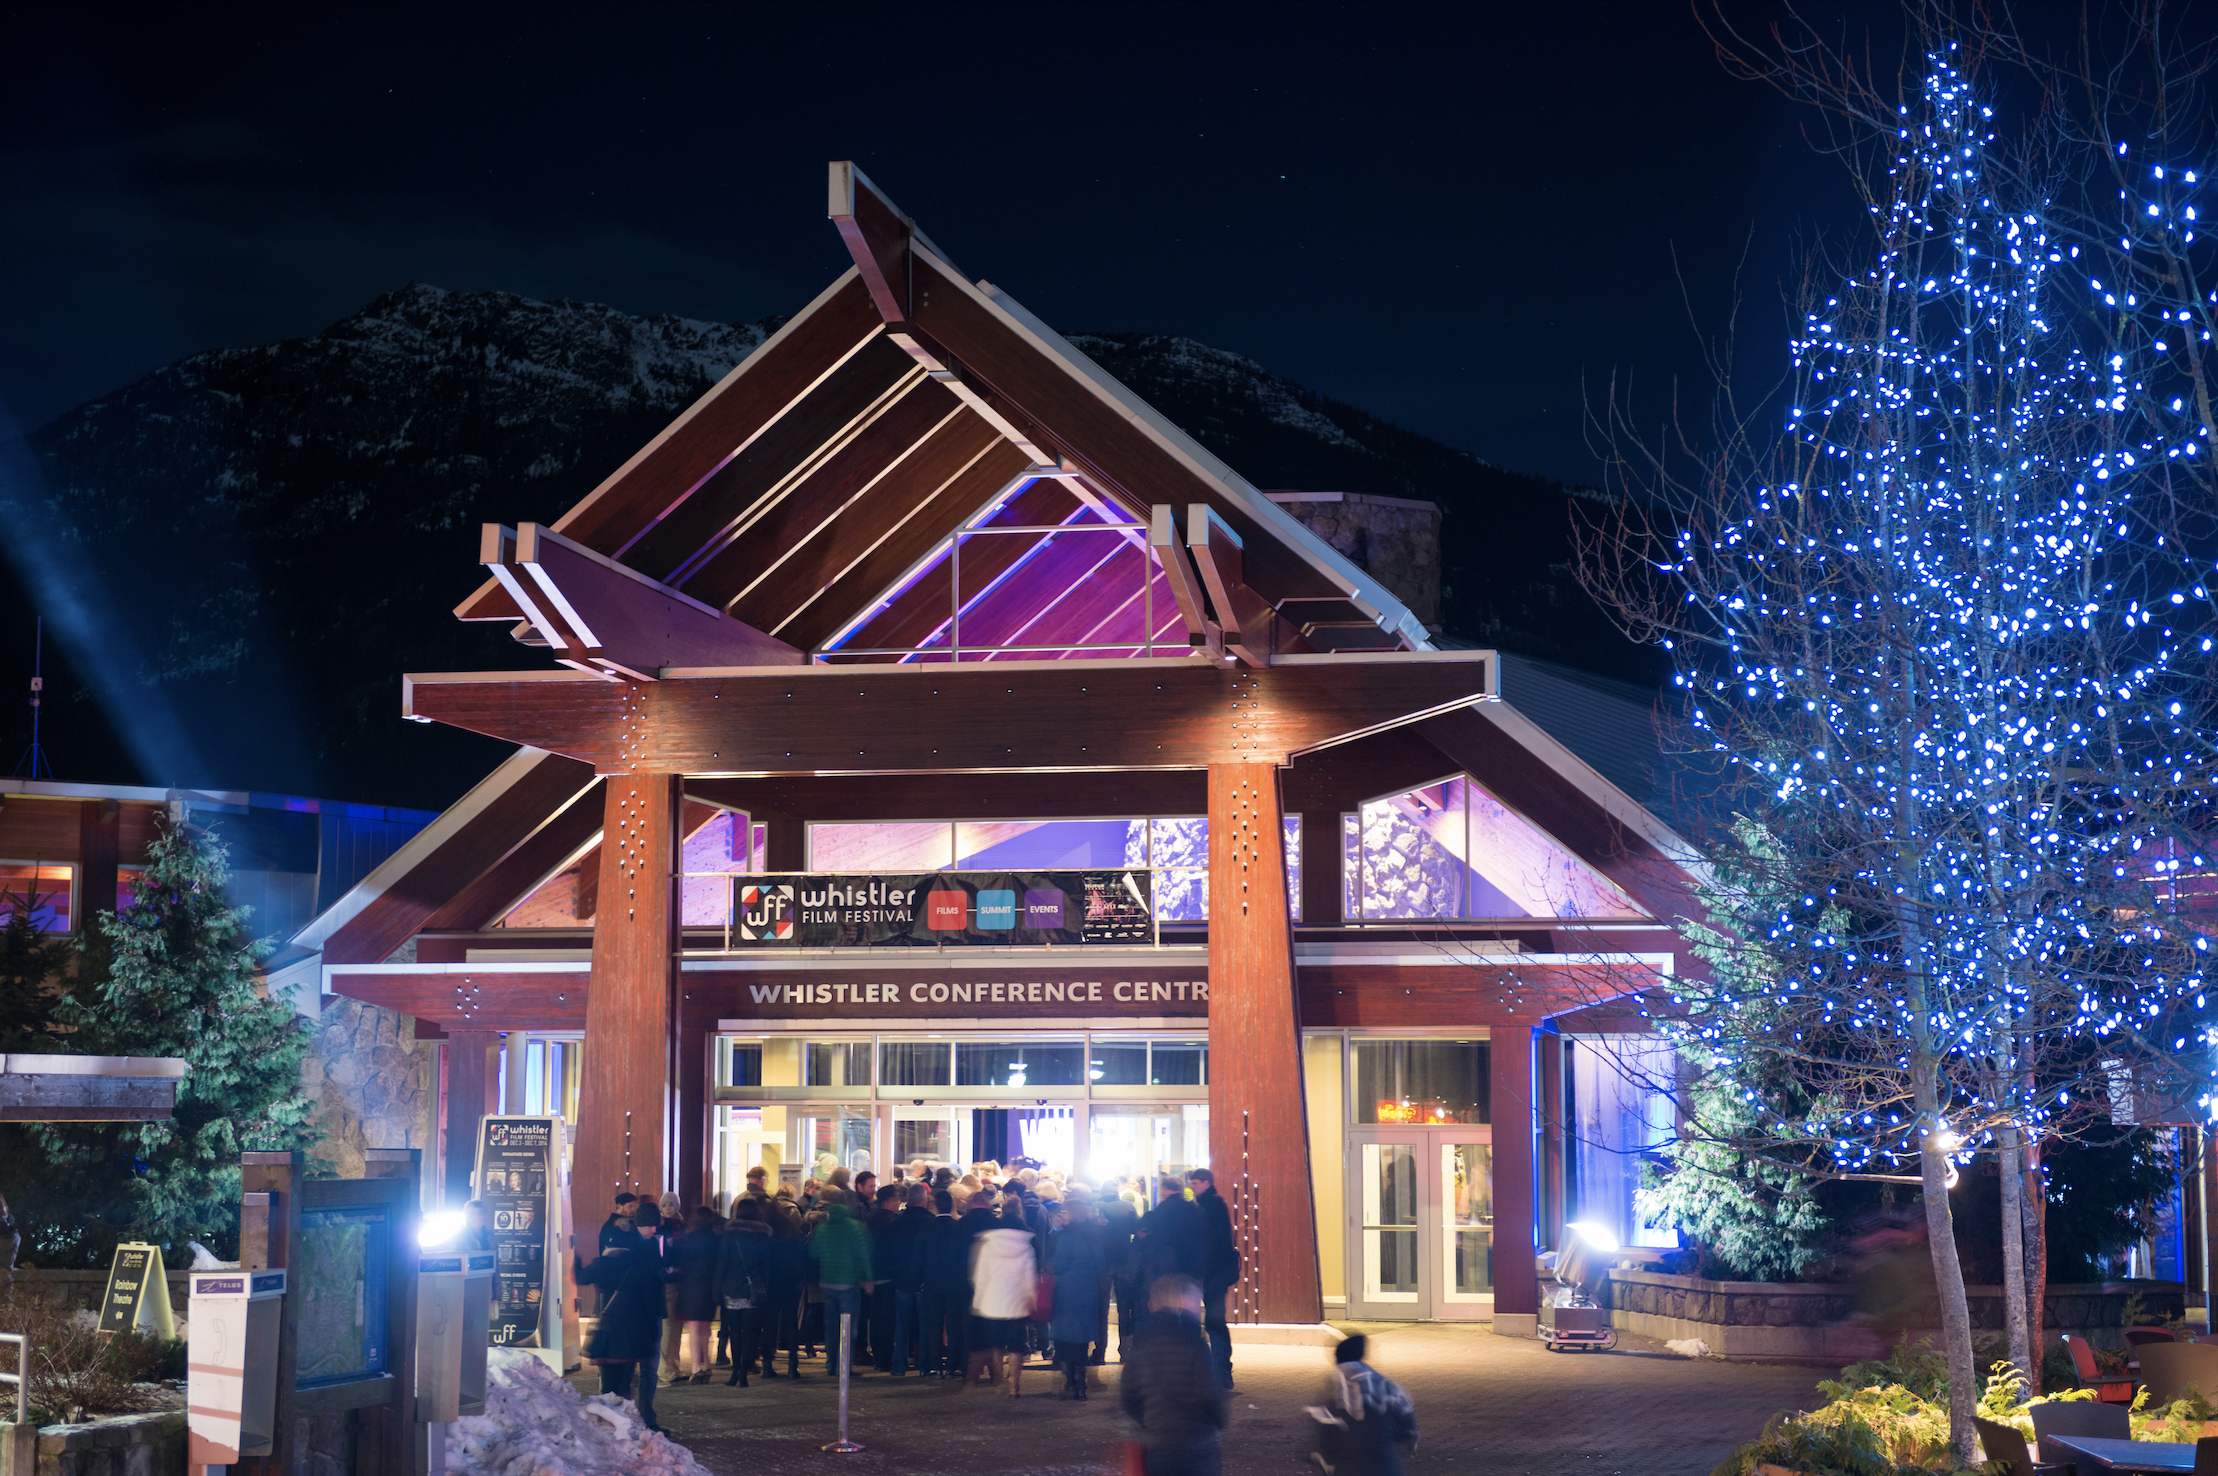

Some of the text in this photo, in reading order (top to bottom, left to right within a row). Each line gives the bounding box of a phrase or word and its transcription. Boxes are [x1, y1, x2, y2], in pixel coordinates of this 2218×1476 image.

[800, 882, 916, 907] whistler
[936, 906, 959, 915] FILMS
[980, 905, 1012, 914] SUMMIT
[1029, 904, 1059, 914] EVENTS
[802, 909, 914, 923] FILM FESTIVAL
[749, 981, 1209, 1004] WHISTLER CONFERENCE CENTR
[510, 1124, 549, 1134] whistler
[115, 1279, 139, 1291] Rainbow
[113, 1293, 133, 1305] Theatre
[493, 1324, 517, 1344] wff
